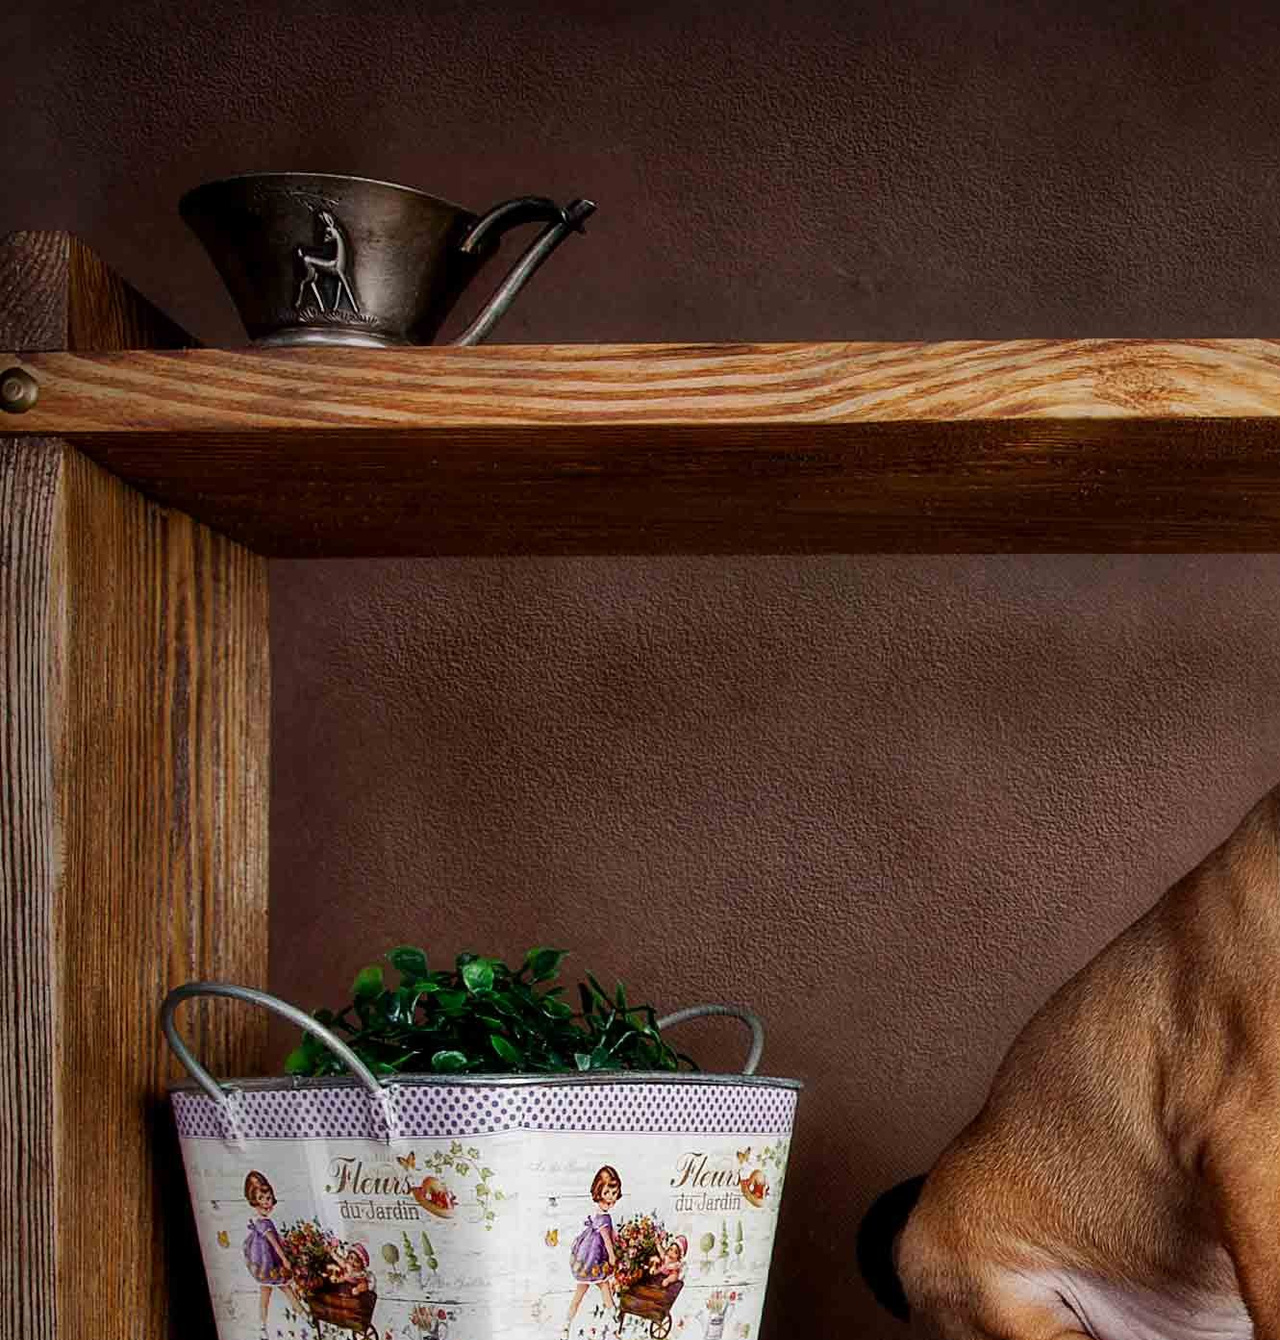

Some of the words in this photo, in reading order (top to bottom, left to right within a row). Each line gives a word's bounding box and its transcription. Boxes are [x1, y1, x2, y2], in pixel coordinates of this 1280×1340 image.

[325, 1154, 412, 1196] Fleurs
[670, 1151, 741, 1189] Fleurs
[365, 1200, 420, 1220] Jardin
